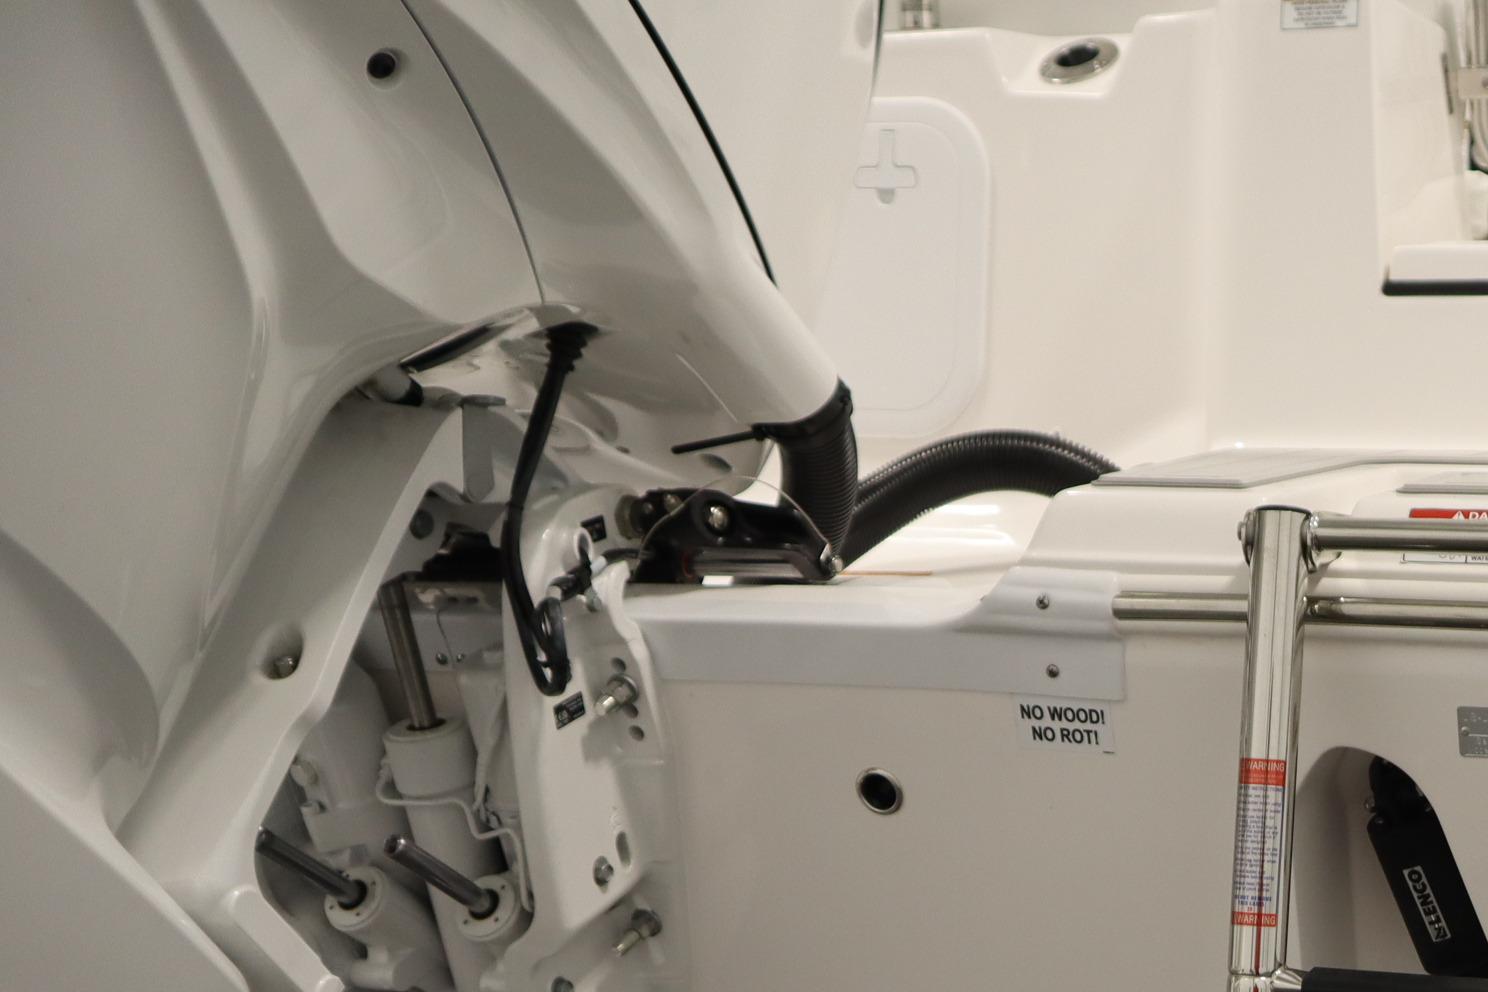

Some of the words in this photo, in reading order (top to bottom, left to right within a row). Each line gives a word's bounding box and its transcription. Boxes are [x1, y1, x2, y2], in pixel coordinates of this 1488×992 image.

[1020, 704, 1044, 720] NO
[1047, 706, 1105, 724] WOOD!
[1032, 726, 1055, 742] NO
[1060, 728, 1099, 745] ROT!
